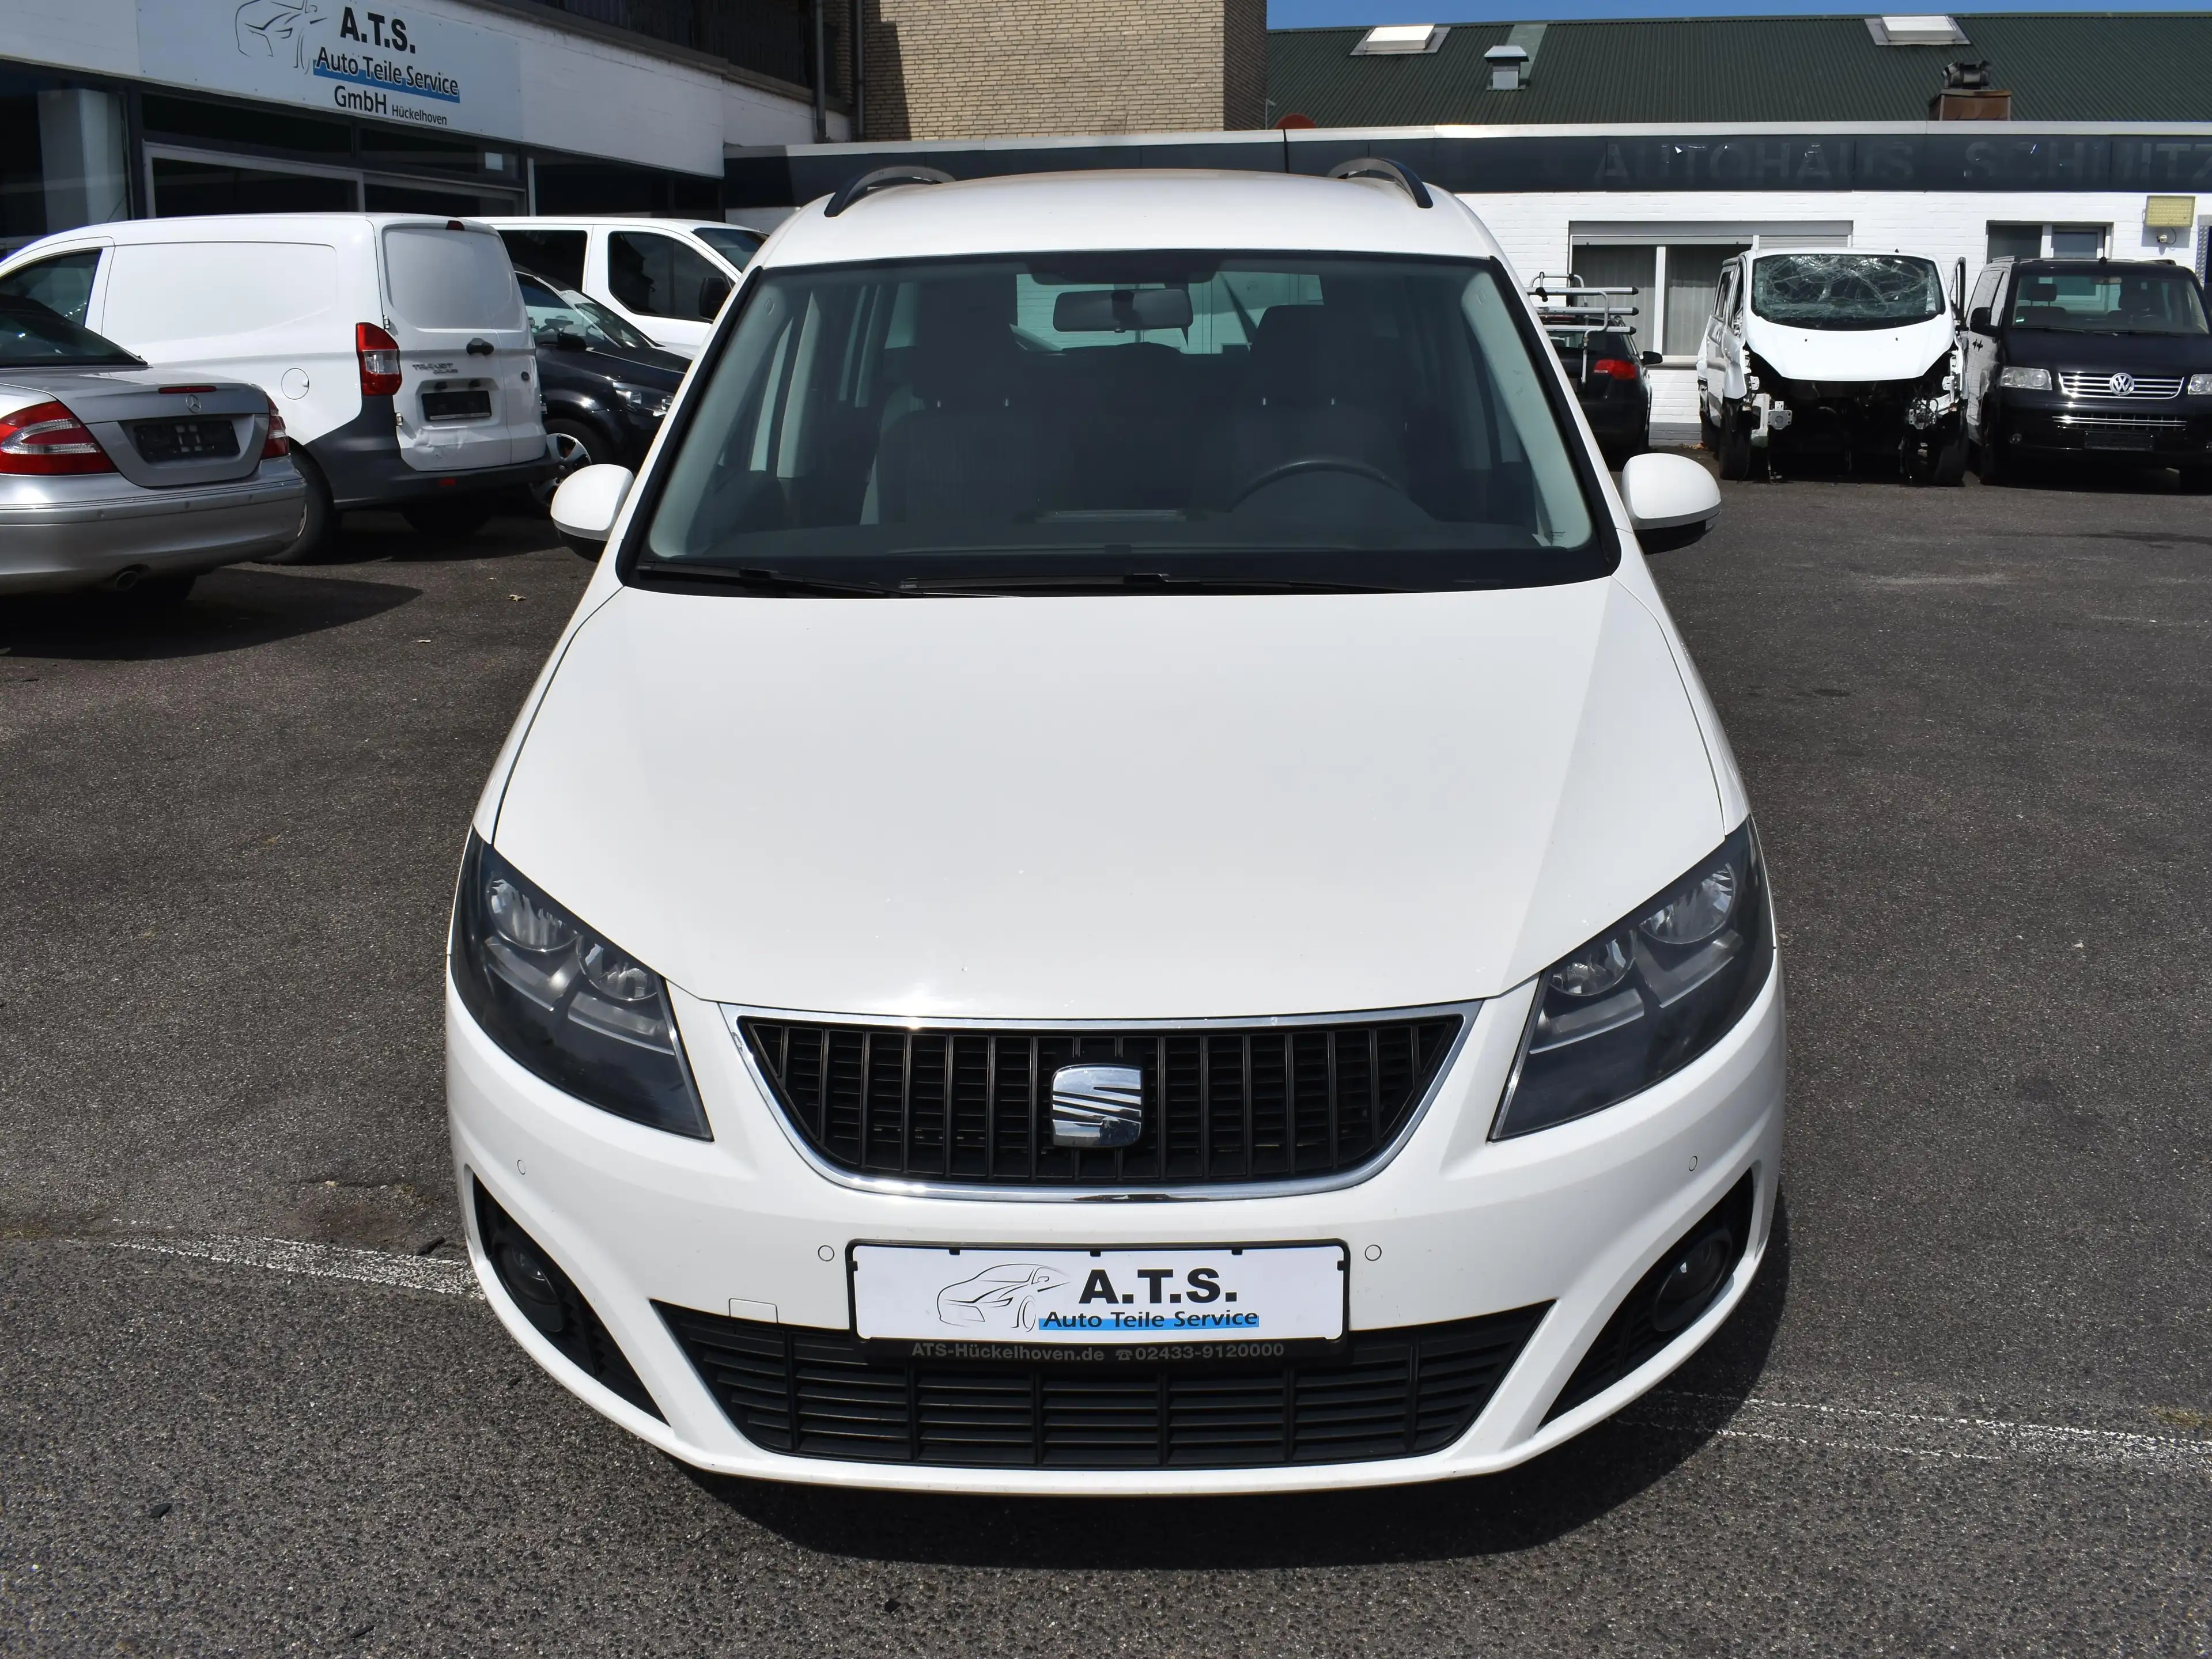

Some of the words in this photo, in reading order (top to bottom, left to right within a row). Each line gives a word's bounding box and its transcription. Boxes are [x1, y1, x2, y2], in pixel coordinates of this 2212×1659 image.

[340, 6, 416, 54] A.T.S.
[316, 47, 358, 75] Auto
[362, 56, 402, 84] Teile
[406, 65, 459, 96] Service
[334, 85, 387, 114] GmbH
[392, 104, 447, 126] Hückelhoven
[1079, 1267, 1237, 1304] A.T.S.
[1043, 1312, 1102, 1328] Auto
[1110, 1311, 1164, 1328] Teile
[1174, 1310, 1257, 1327] Service
[912, 1342, 1105, 1361] ATS-Hückelhoven.de
[1135, 1343, 1284, 1360] 02433-9120000
